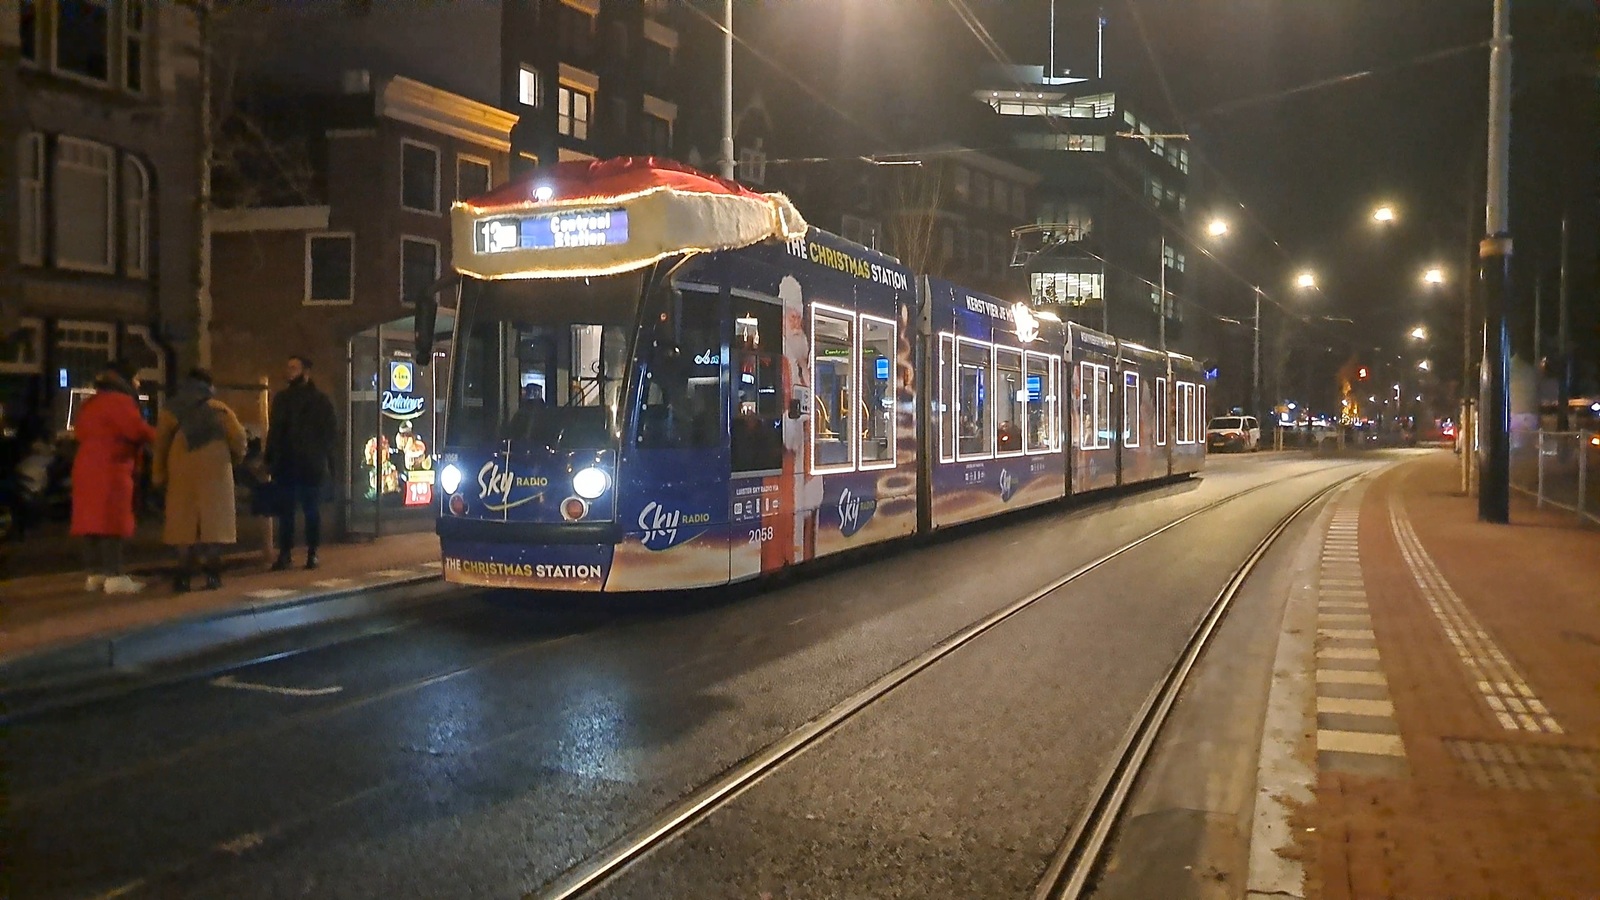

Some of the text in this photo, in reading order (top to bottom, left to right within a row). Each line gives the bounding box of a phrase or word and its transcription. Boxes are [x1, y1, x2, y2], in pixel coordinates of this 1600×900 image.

[550, 212, 611, 237] Centraal
[554, 231, 606, 247] Station
[785, 238, 907, 291] THE CHRISTMAS STATION
[965, 294, 986, 314] KERST
[478, 461, 548, 502] Sky RADIO
[839, 487, 860, 531] Sky
[638, 501, 710, 545] Sky RADIO
[748, 526, 774, 544] 2058
[445, 557, 601, 578] THE CHRISTMAS STATION
